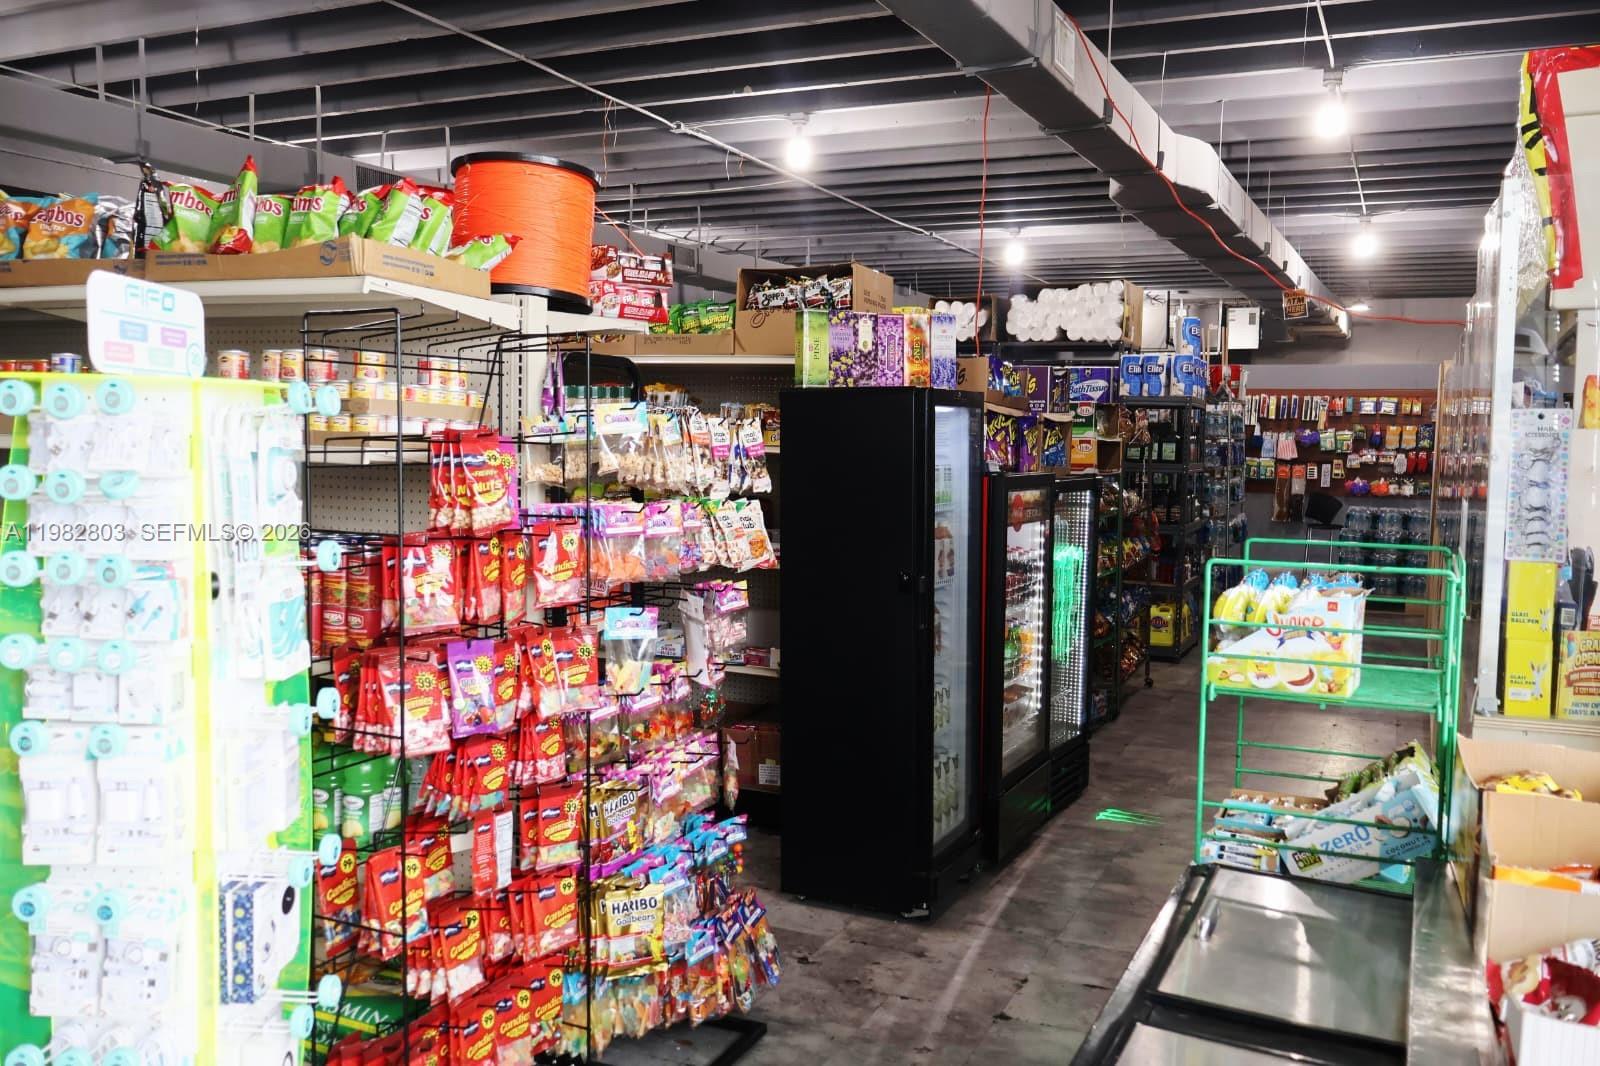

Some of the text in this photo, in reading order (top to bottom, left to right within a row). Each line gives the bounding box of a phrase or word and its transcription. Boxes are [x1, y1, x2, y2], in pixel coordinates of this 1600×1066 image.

[913, 335, 922, 370] HONEY
[1147, 365, 1163, 373] Elite
[563, 882, 572, 890] 99
[389, 888, 424, 915] Cadies
[612, 897, 657, 915] HARIBO
[544, 903, 576, 926] Candies
[450, 931, 480, 959] Candies
